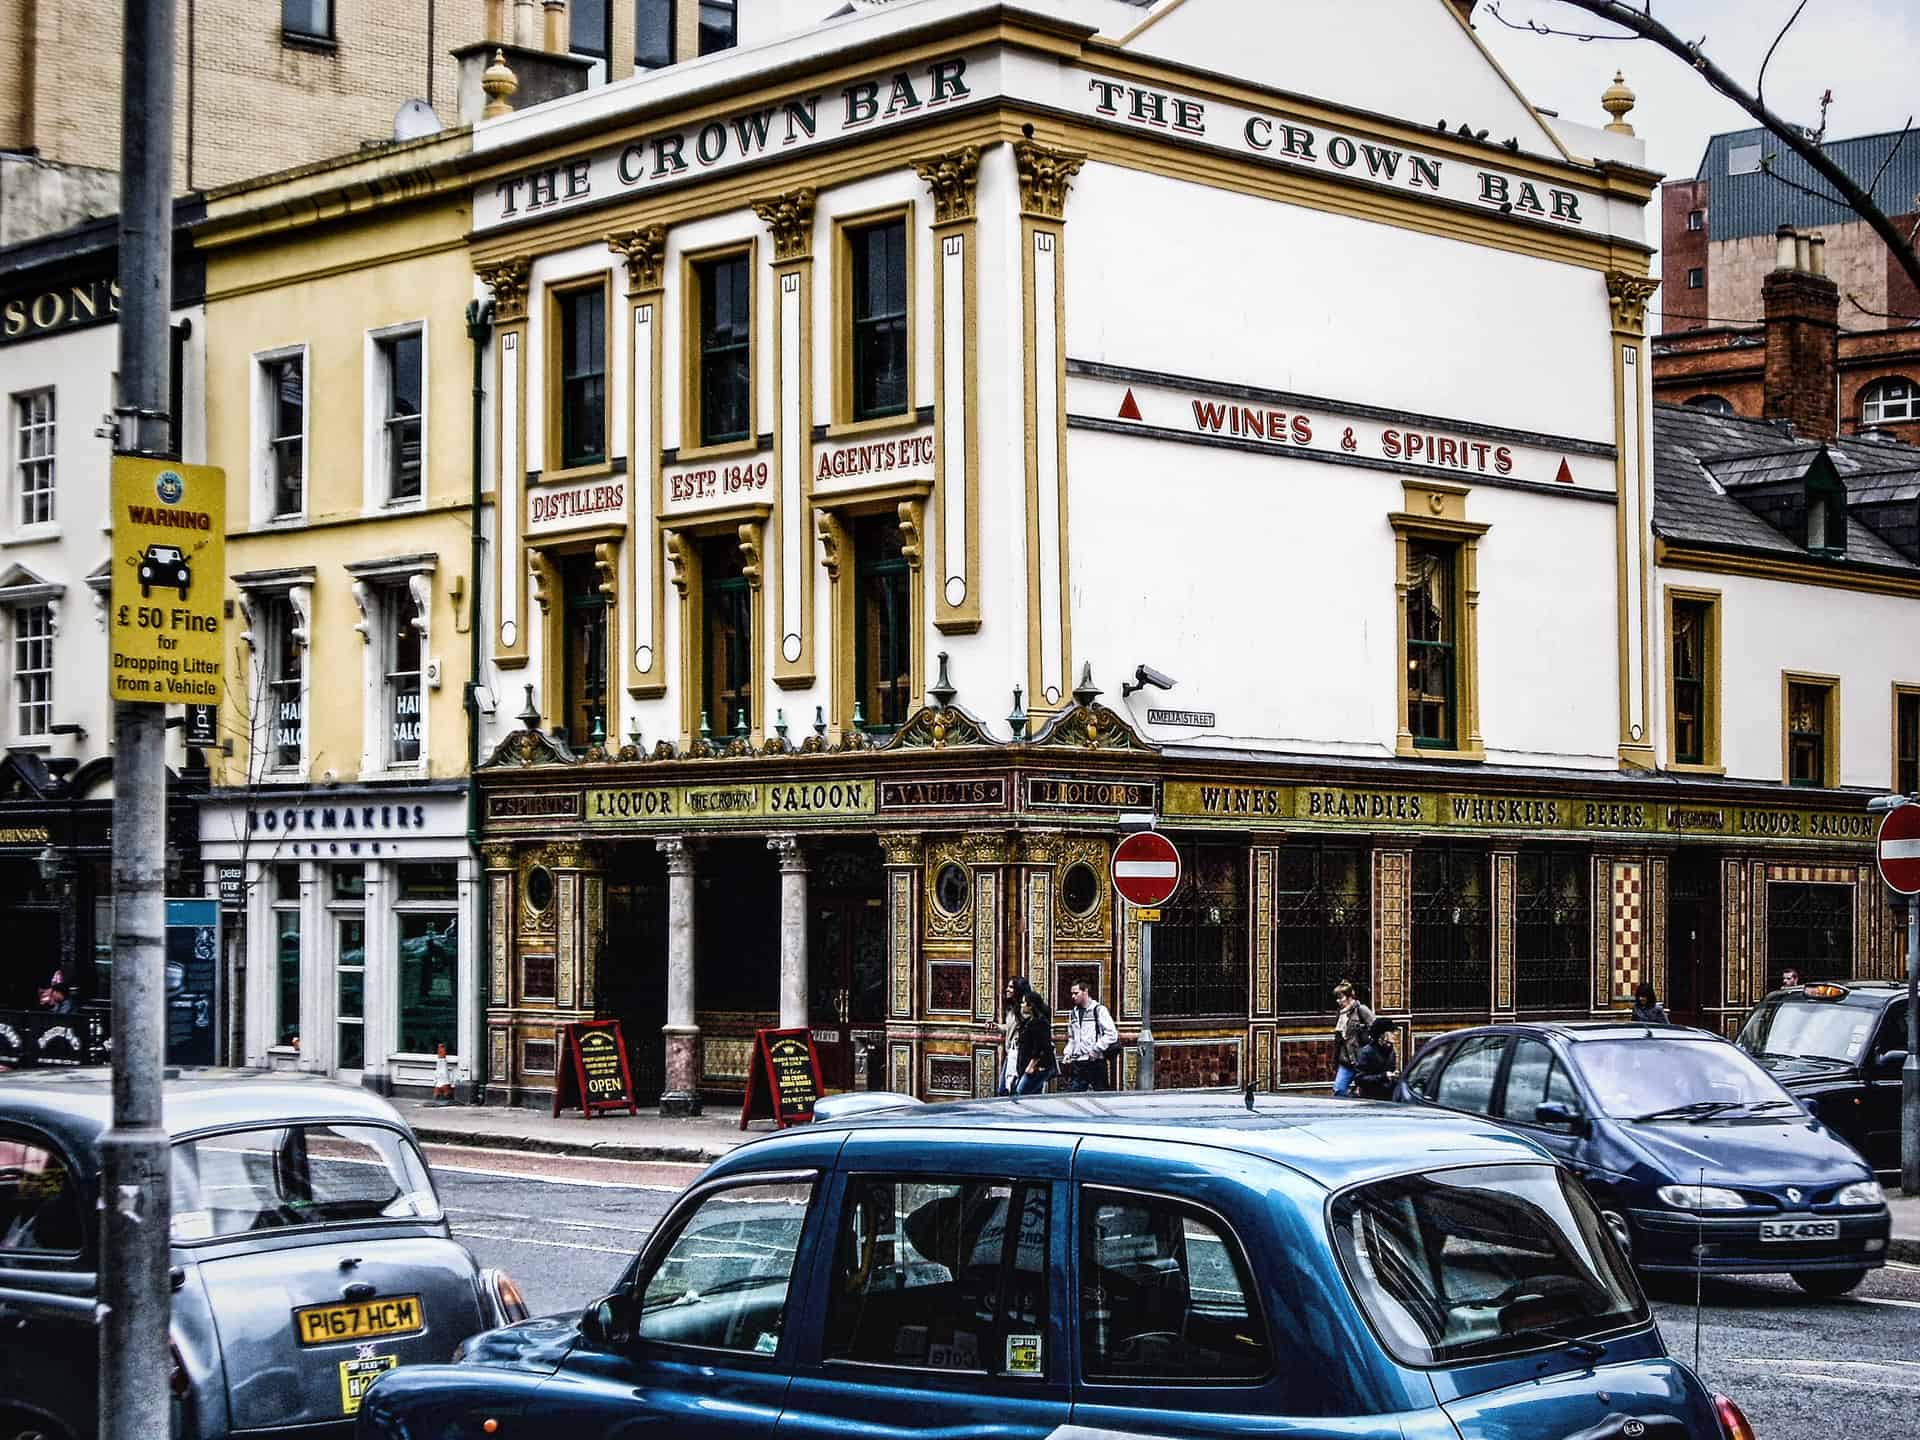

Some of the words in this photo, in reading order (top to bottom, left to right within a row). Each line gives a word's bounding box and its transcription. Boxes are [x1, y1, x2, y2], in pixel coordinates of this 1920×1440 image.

[497, 158, 592, 218] THE
[616, 95, 821, 186] CROWN
[841, 57, 970, 129] BAR
[1088, 78, 1206, 135] THE
[1243, 116, 1443, 190] CROWN
[1477, 171, 1583, 223] BAR
[1192, 398, 1312, 445] WINES
[1340, 425, 1357, 450] &
[1381, 428, 1513, 474] SPIRITS
[816, 441, 897, 481] AGENTS
[723, 462, 769, 494] 1849
[532, 484, 624, 522] DISTILLERS
[127, 504, 211, 531] WARNING
[117, 604, 129, 627] £
[137, 605, 162, 628] 50
[171, 608, 217, 633] Fine
[158, 634, 178, 650] for
[114, 653, 178, 675] Dropping
[184, 656, 220, 674] Litter
[116, 674, 149, 691] from
[154, 681, 162, 692] a
[166, 677, 217, 695] Vehicle
[1151, 711, 1181, 722] AMELIA
[1183, 714, 1212, 724] STREET
[595, 791, 672, 816] LIQUOR
[897, 783, 986, 803] VAULTS
[249, 805, 426, 833] BOOKMAKERS
[1740, 811, 1801, 833] LIQUOR
[588, 1078, 622, 1093] OPEN
[306, 1308, 362, 1338] P167
[366, 1301, 414, 1331] HCM
[360, 1361, 378, 1370] TAXI
